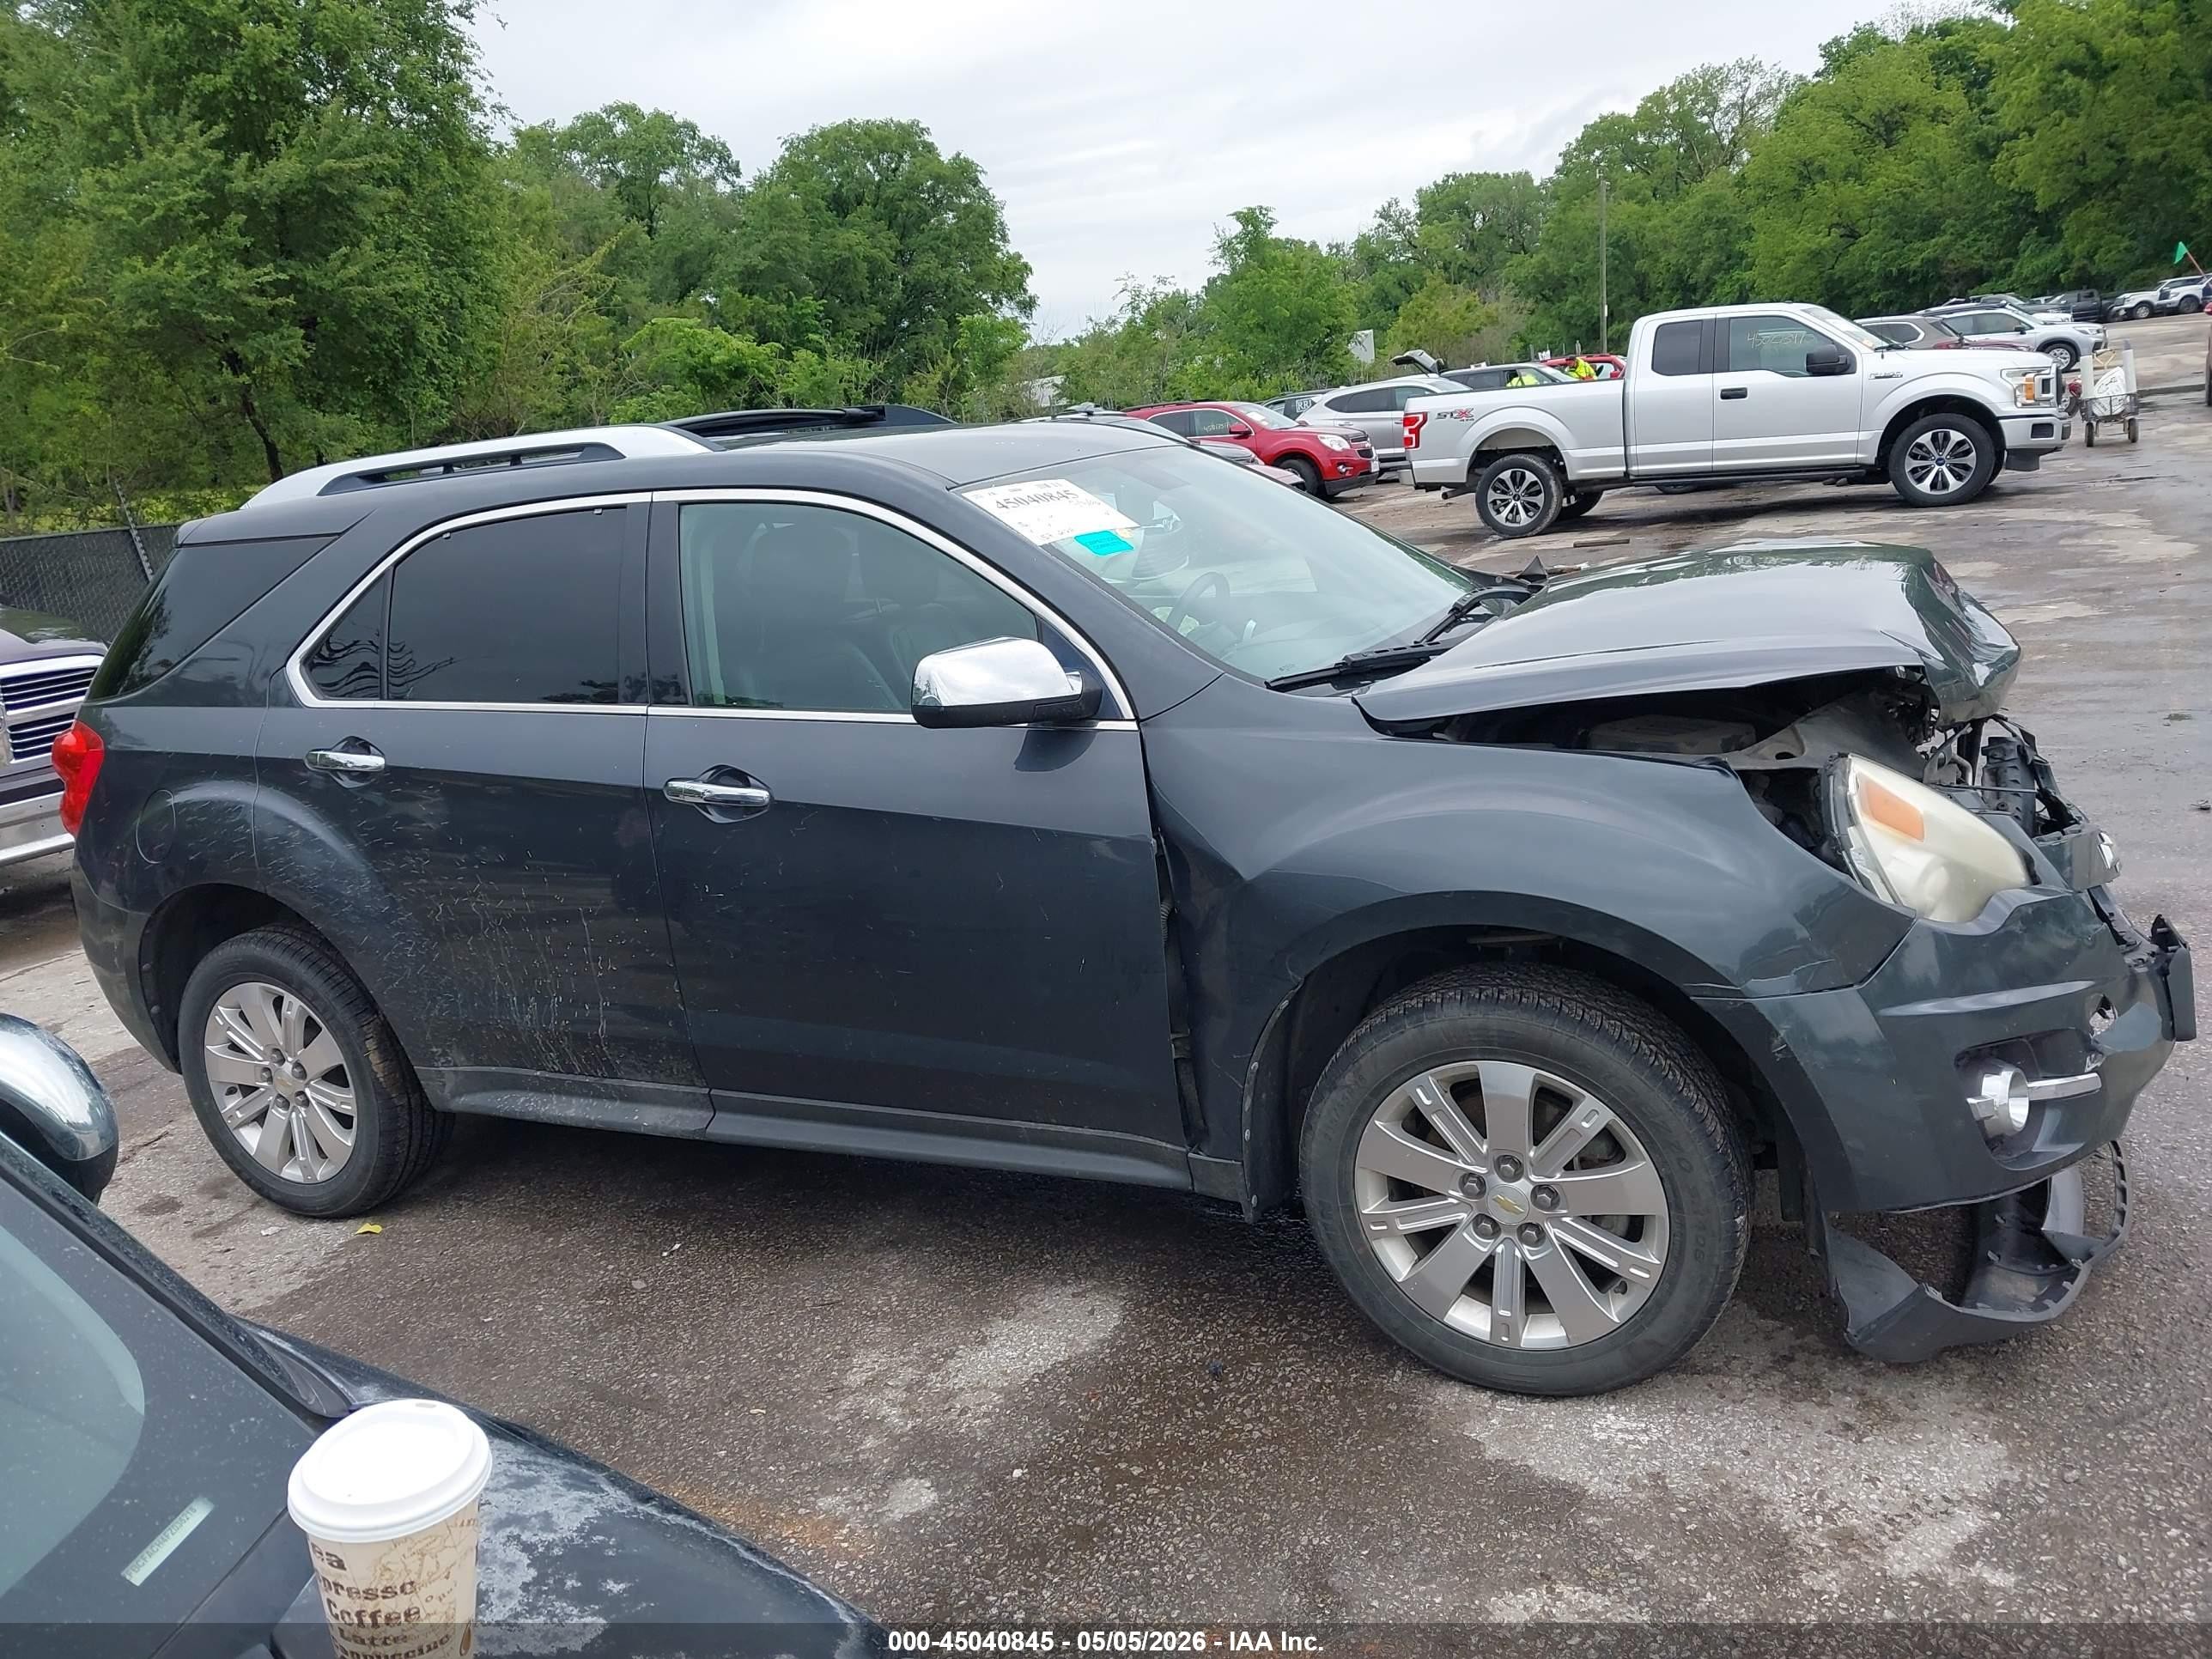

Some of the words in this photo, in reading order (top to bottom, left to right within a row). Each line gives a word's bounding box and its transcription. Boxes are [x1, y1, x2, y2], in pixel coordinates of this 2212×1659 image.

[996, 489, 1079, 509] 45040845
[311, 1541, 347, 1571] ea
[319, 1576, 416, 1601] presso
[326, 1597, 421, 1630] Coffee
